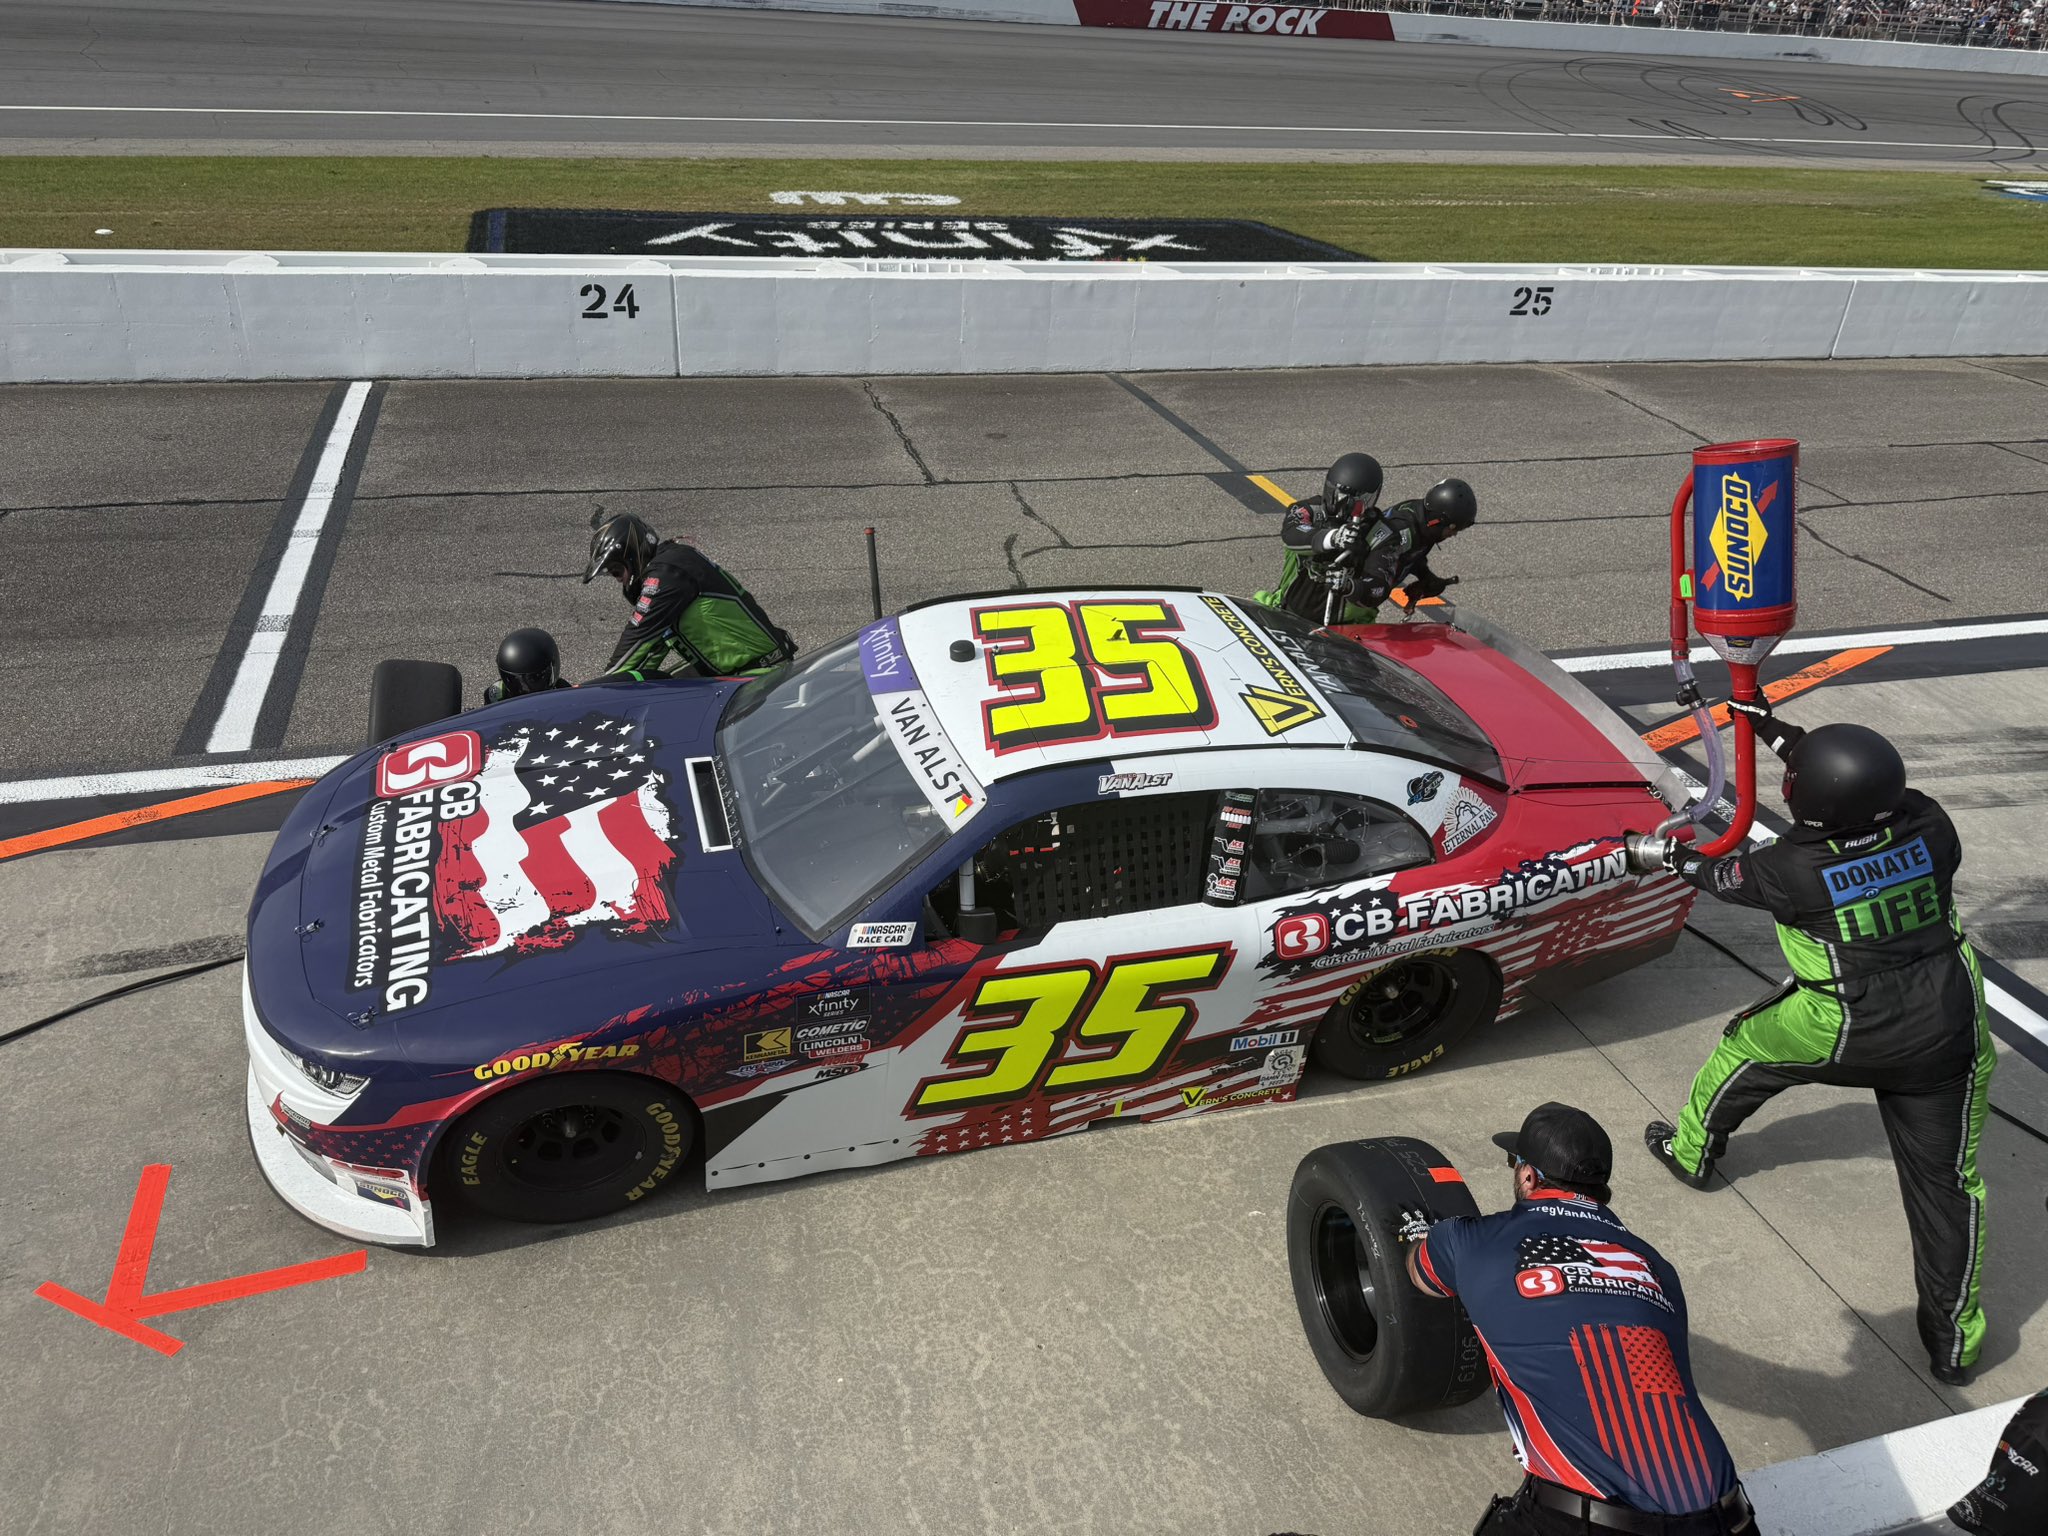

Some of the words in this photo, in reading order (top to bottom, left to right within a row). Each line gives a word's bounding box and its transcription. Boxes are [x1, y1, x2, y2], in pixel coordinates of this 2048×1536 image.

[1147, 3, 1213, 31] THE
[1220, 6, 1328, 35] ROCK
[580, 283, 640, 319] 24
[1509, 286, 1554, 316] 25
[1725, 477, 1750, 595] SUNOCO
[1202, 596, 1270, 656] CONCRETE
[863, 624, 899, 678] xfinity
[1263, 625, 1315, 663] ALST
[971, 600, 1214, 753] 35
[890, 697, 932, 746] VAN
[914, 746, 973, 804] ALST
[439, 781, 477, 820] CB
[363, 800, 393, 846] Custom
[1443, 822, 1482, 853] ETERNAL
[1478, 807, 1496, 827] FAN
[360, 846, 386, 892] Metal
[1218, 878, 1236, 887] ACE
[1830, 843, 1928, 893] DONATE
[385, 789, 433, 1012] FABRICATING
[1334, 908, 1395, 942] CB
[1406, 850, 1627, 928] FABRICATIN
[1843, 882, 1938, 941] LIFE
[353, 893, 383, 987] Fabricators
[857, 936, 883, 944] RACE
[884, 935, 904, 943] CAR
[868, 925, 908, 935] NASCAR
[1315, 945, 1373, 970] Custom
[1373, 935, 1416, 959] Metal
[1416, 922, 1495, 950] Fabricators
[808, 997, 859, 1016] xfinity
[824, 989, 851, 999] NASCAR
[796, 1020, 867, 1039] COMETIC
[823, 1009, 845, 1017] SERIES
[911, 949, 1226, 1112] 35
[745, 1048, 788, 1060] KENNAMETAL
[803, 1036, 858, 1051] LINCOLN
[815, 1044, 863, 1056] WELDERS
[1232, 1033, 1278, 1050] Mobil
[473, 1042, 640, 1081] GOODYEAR
[814, 1065, 854, 1079] MSD
[1277, 1056, 1289, 1068] 5
[1385, 1044, 1445, 1078] EAGLE
[1180, 1086, 1229, 1107] VERN'S
[1230, 1087, 1282, 1101] CONCRETE
[460, 1131, 488, 1185] EAGLE
[624, 1101, 682, 1201] GOODYEAR
[358, 1182, 406, 1200] SUNOCO
[1528, 1205, 1627, 1232] regVanAlst.com
[1563, 1266, 1591, 1276] CB
[1566, 1275, 1676, 1313] FABRICATING
[1568, 1285, 1603, 1294] Custom
[1604, 1287, 1631, 1297] Metal
[1632, 1291, 1670, 1312] Fabricators
[2007, 1448, 2039, 1477] SCAR
